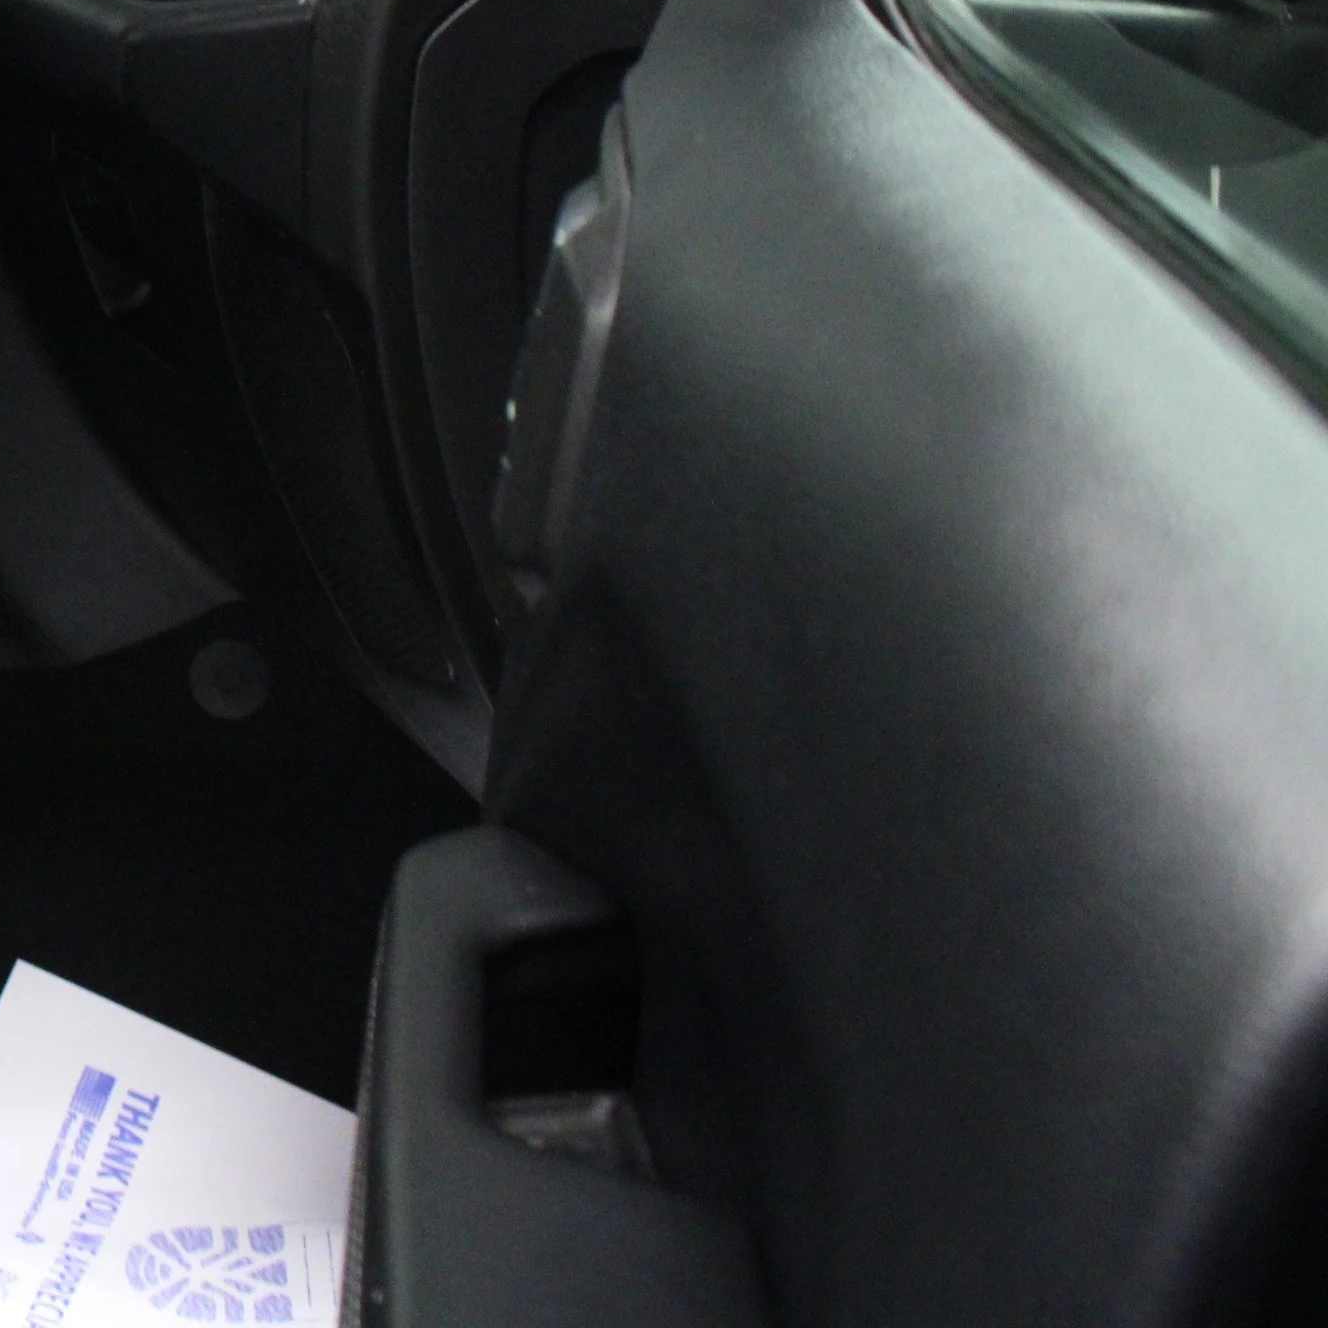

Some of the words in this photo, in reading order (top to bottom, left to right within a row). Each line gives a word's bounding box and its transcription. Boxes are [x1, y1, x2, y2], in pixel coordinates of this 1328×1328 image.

[71, 1120, 96, 1160] MADE
[97, 1089, 160, 1186] THANK
[70, 1187, 124, 1228] YOU,
